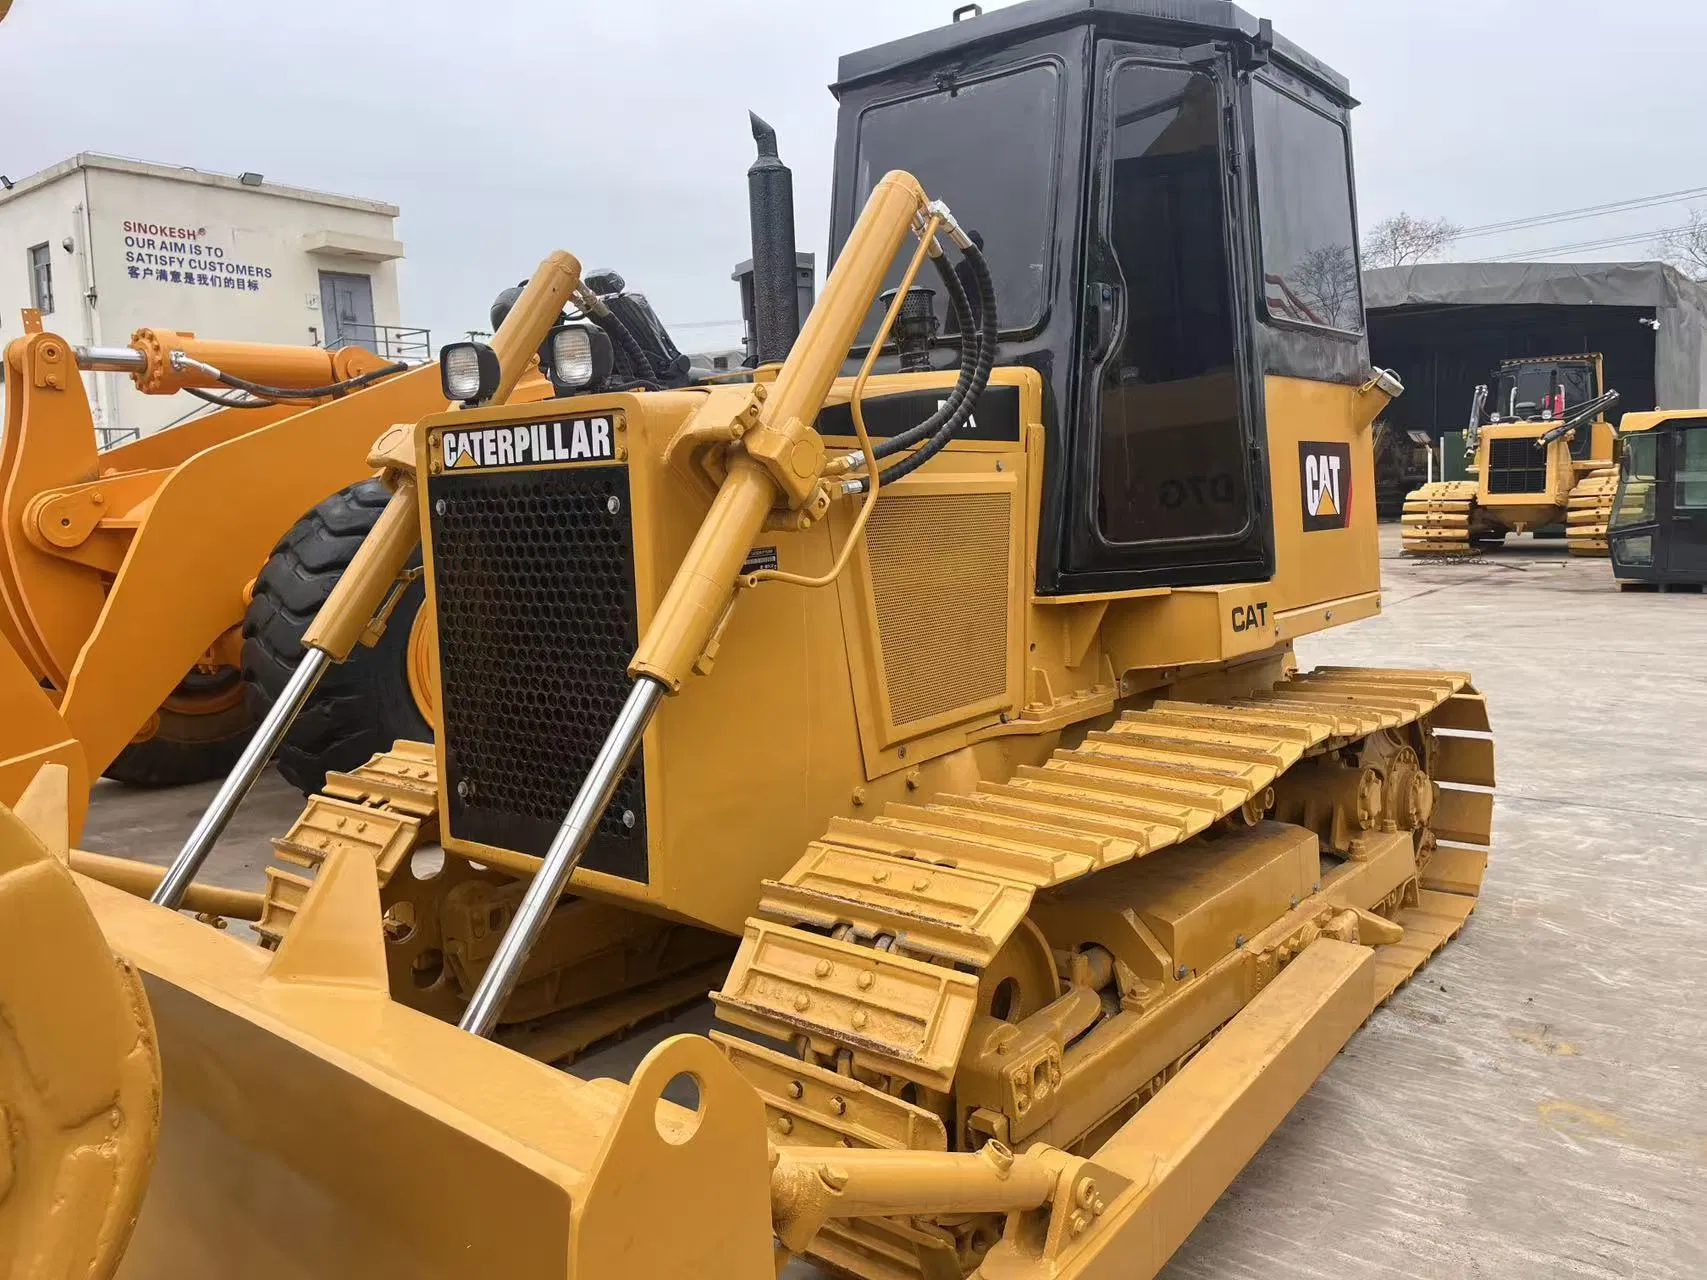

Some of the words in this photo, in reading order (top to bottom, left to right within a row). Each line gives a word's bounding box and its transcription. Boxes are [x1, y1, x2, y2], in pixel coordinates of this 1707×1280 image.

[124, 235, 156, 250] OUR
[160, 240, 186, 254] AIM
[189, 244, 202, 256] IS
[205, 246, 224, 258] TO
[126, 251, 185, 268] SATISFY
[188, 258, 272, 278] CUSTOMERS
[127, 265, 260, 291] 客户满意是我们的目标
[443, 418, 611, 467] CATERPILLAR
[1305, 454, 1341, 517] CAT
[1231, 601, 1269, 633] CAT
